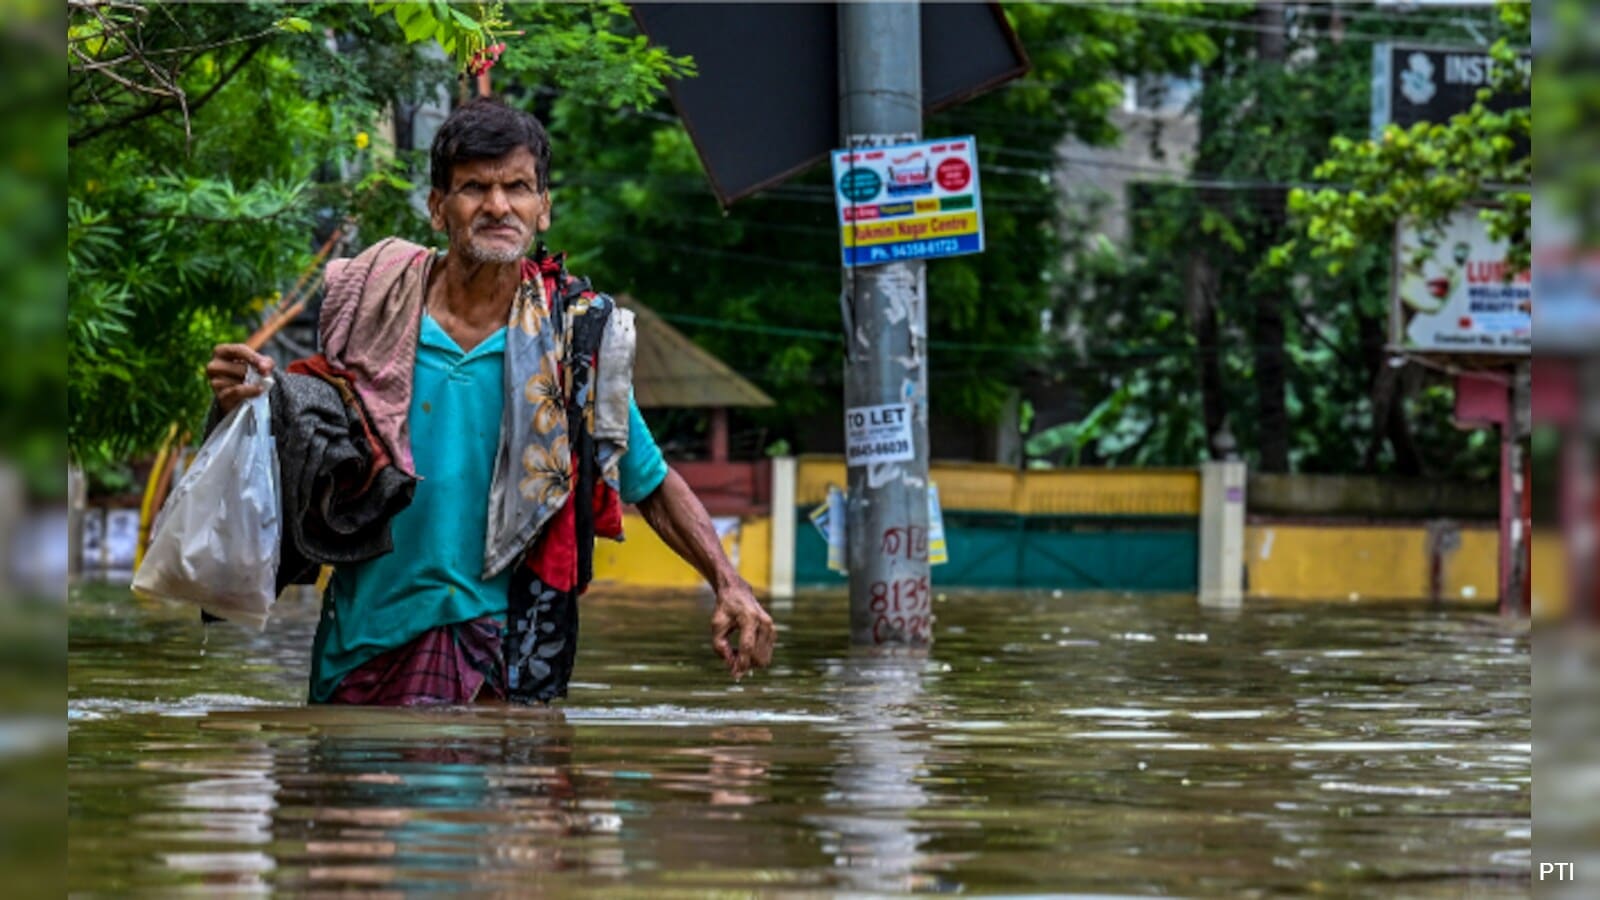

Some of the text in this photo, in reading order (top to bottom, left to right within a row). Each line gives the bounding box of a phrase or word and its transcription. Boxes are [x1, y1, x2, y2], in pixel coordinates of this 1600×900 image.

[898, 220, 928, 239] Nagar
[931, 217, 968, 234] Centre
[848, 407, 906, 429] TO LET
